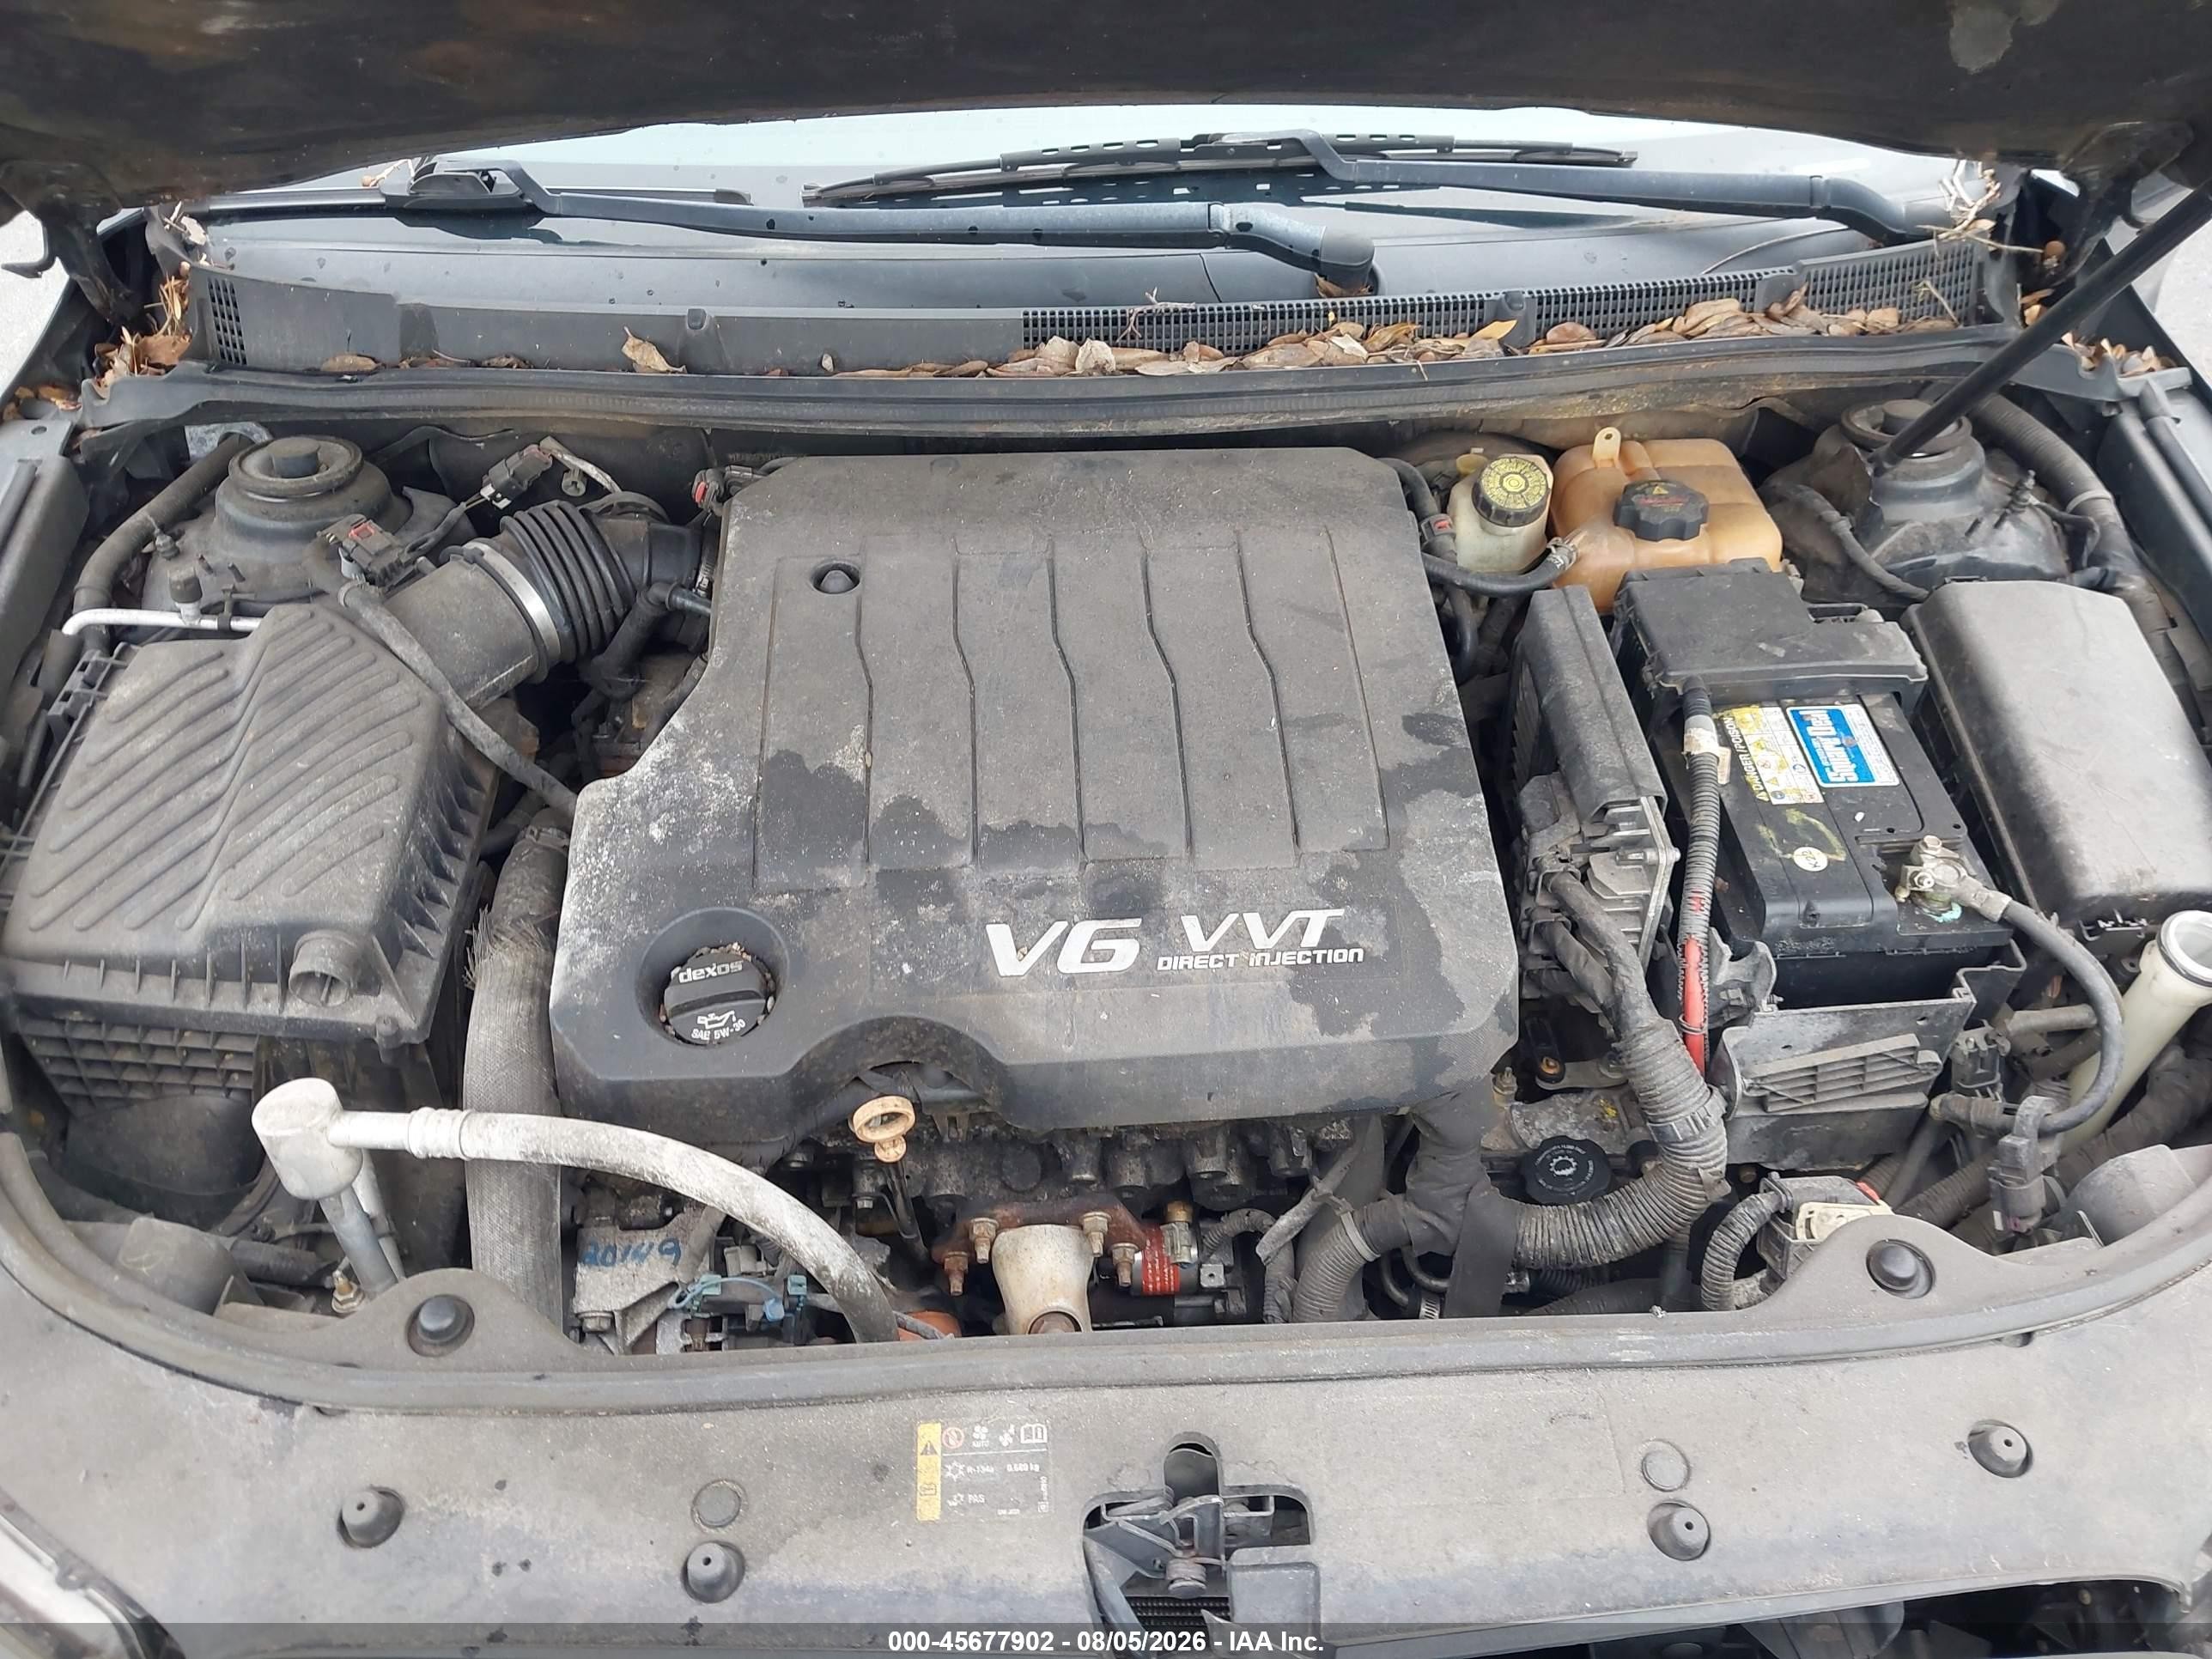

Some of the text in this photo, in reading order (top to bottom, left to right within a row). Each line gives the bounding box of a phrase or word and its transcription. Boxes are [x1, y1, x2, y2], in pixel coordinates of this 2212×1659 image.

[1798, 709, 1838, 737] Deal
[1819, 736, 1862, 782] Square
[985, 908, 1346, 977] V6 VVT
[678, 960, 744, 984] dexos
[1157, 953, 1239, 971] DIRECT
[691, 1018, 746, 1041] SAE 5W-30
